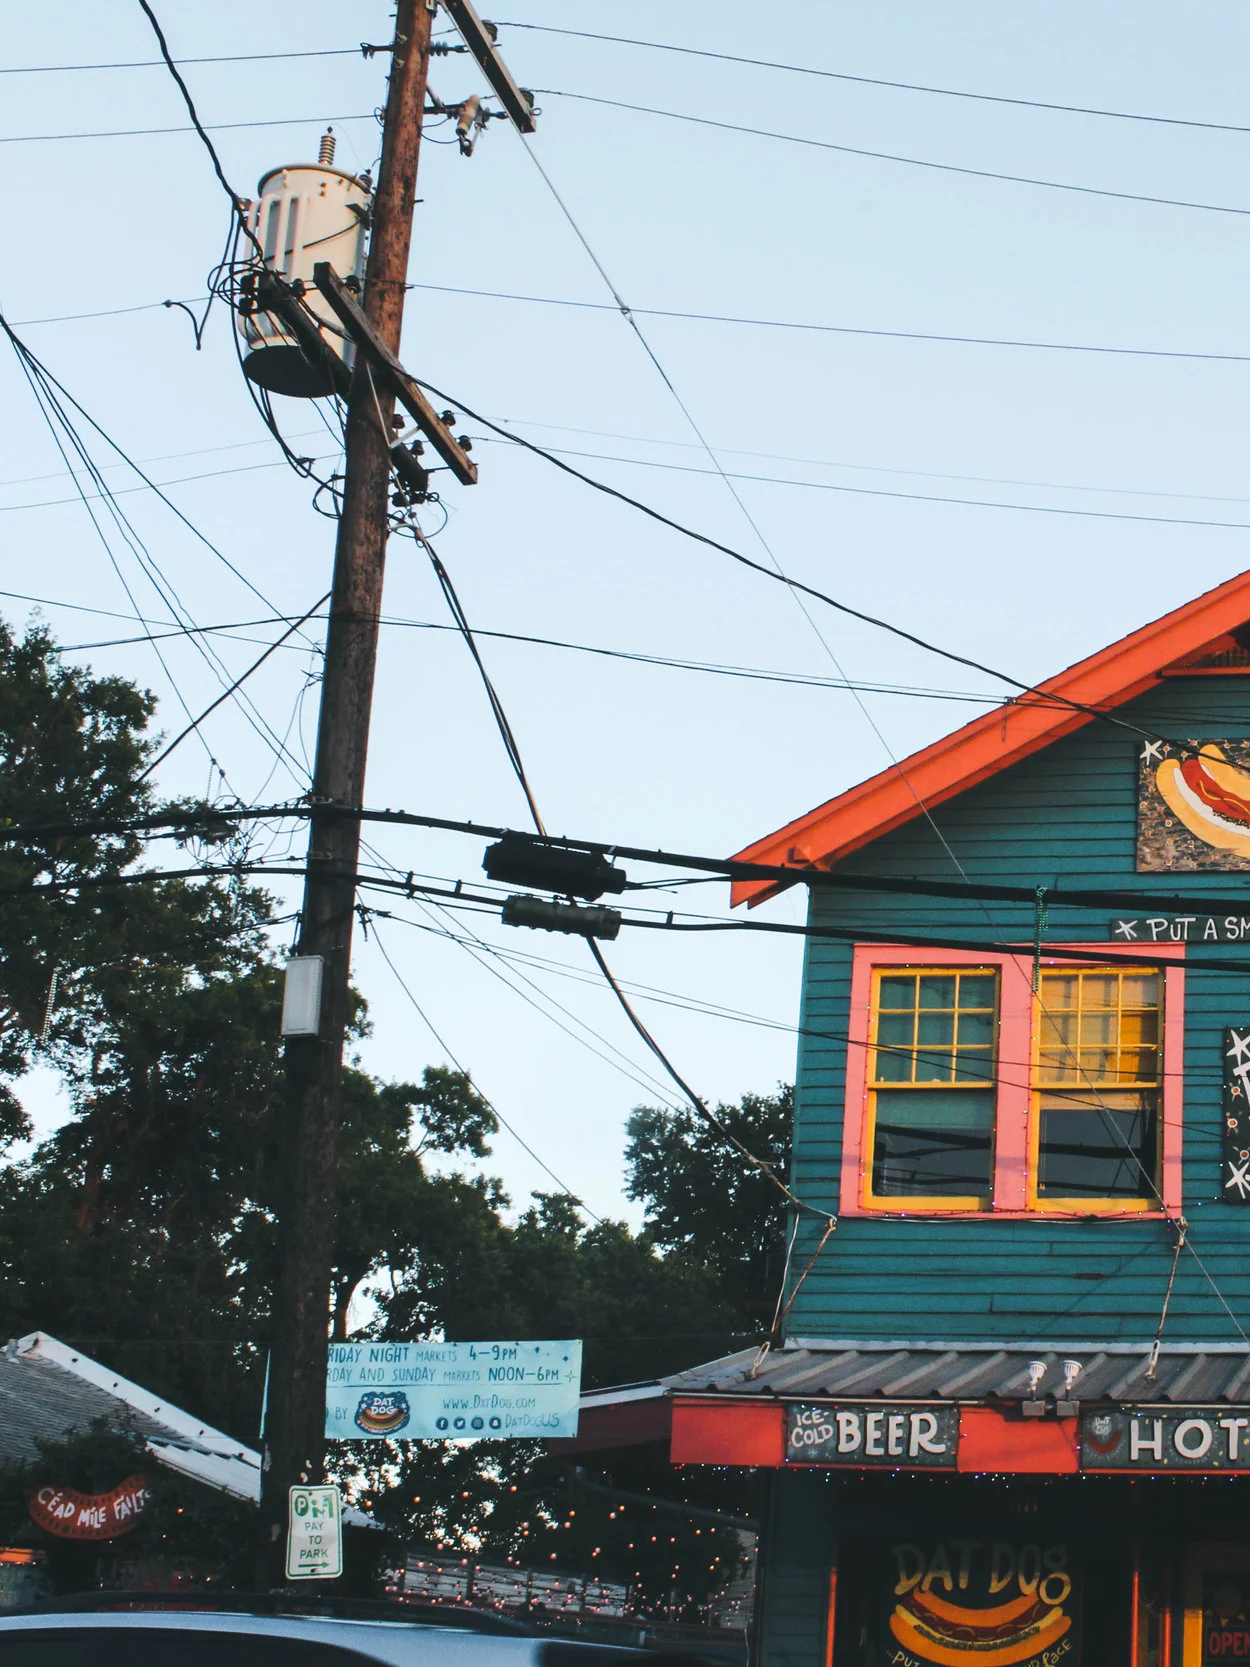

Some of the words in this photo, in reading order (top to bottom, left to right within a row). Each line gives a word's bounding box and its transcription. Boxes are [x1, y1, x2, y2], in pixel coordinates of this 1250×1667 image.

[1146, 917, 1196, 941] PUT
[1203, 918, 1218, 940] A
[328, 1347, 362, 1364] RIDAY
[369, 1347, 409, 1363] NIGHT
[359, 1368, 384, 1382] AND
[392, 1367, 436, 1382] SUNDAY
[443, 1370, 480, 1381] MARKETS
[373, 1398, 395, 1406] DAT
[335, 1407, 348, 1420] BY
[371, 1406, 396, 1415] DOG
[791, 1424, 834, 1448] COLD
[836, 1412, 946, 1457] BEER
[1130, 1419, 1248, 1460] HOT
[304, 1521, 323, 1531] PAY
[308, 1535, 322, 1545] TO
[299, 1549, 329, 1559] PARK
[891, 1541, 983, 1596] DAT
